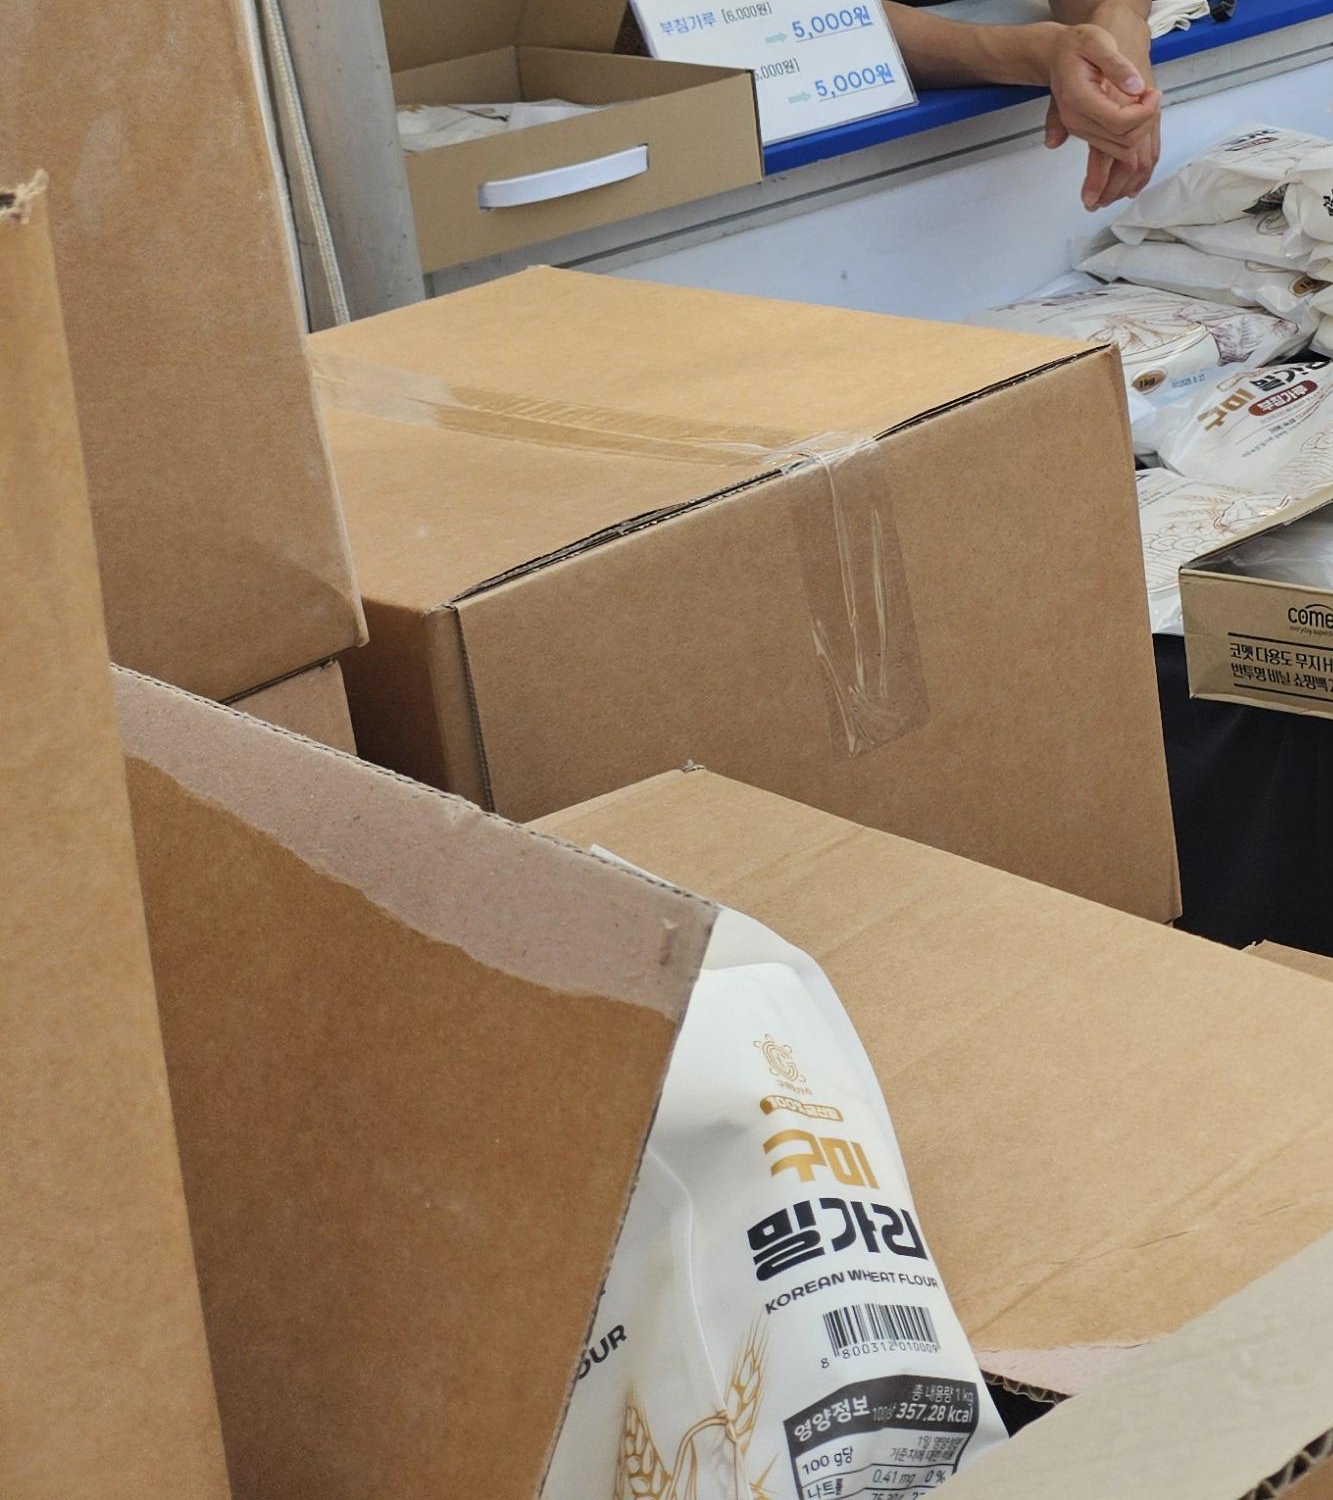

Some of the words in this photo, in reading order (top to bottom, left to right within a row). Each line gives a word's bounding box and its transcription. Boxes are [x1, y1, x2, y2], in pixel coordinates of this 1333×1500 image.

[791, 4, 874, 40] 5,000원
[814, 61, 897, 98] 5,000원
[1197, 387, 1257, 432] 구미
[1231, 662, 1267, 682] 반투명
[1293, 672, 1329, 692] 쇼핑백
[1255, 647, 1293, 667] 다용도
[1295, 653, 1321, 672] 무지
[762, 1129, 881, 1190] 구미
[747, 1197, 929, 1282] 밀가리
[764, 1271, 845, 1315] KOREAN
[847, 1269, 896, 1285] WHEAT
[899, 1272, 940, 1289] FLOUR
[793, 1394, 871, 1442] 영양정보
[896, 1402, 946, 1422] 357.28
[947, 1403, 974, 1424] kcal
[802, 1454, 830, 1476] 100
[872, 1469, 898, 1483] 0.41
